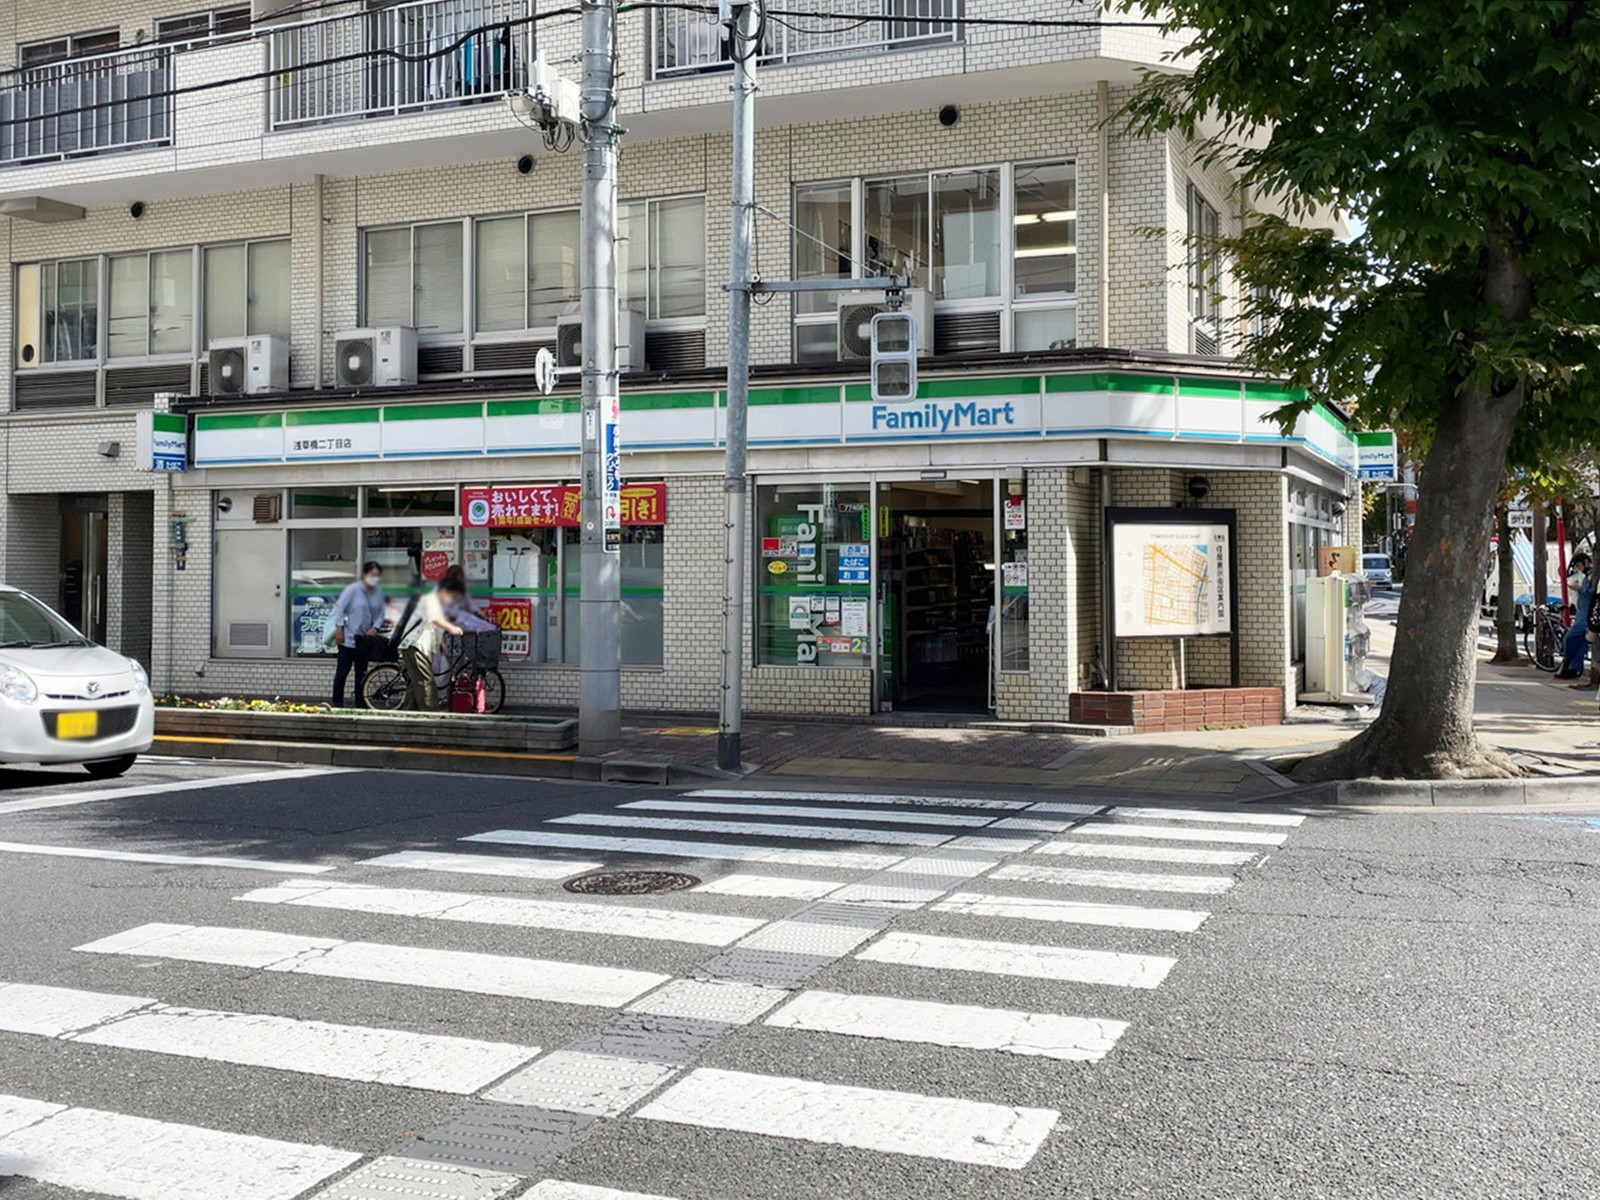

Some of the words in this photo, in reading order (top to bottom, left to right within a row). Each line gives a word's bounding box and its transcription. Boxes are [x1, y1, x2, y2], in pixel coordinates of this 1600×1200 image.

[872, 402, 1014, 433] FamilyMart
[293, 438, 352, 451] 浅草橋二丁目店
[491, 489, 559, 504] おいしくて、
[491, 502, 559, 519] 売れてます!
[843, 558, 864, 566] たばこ
